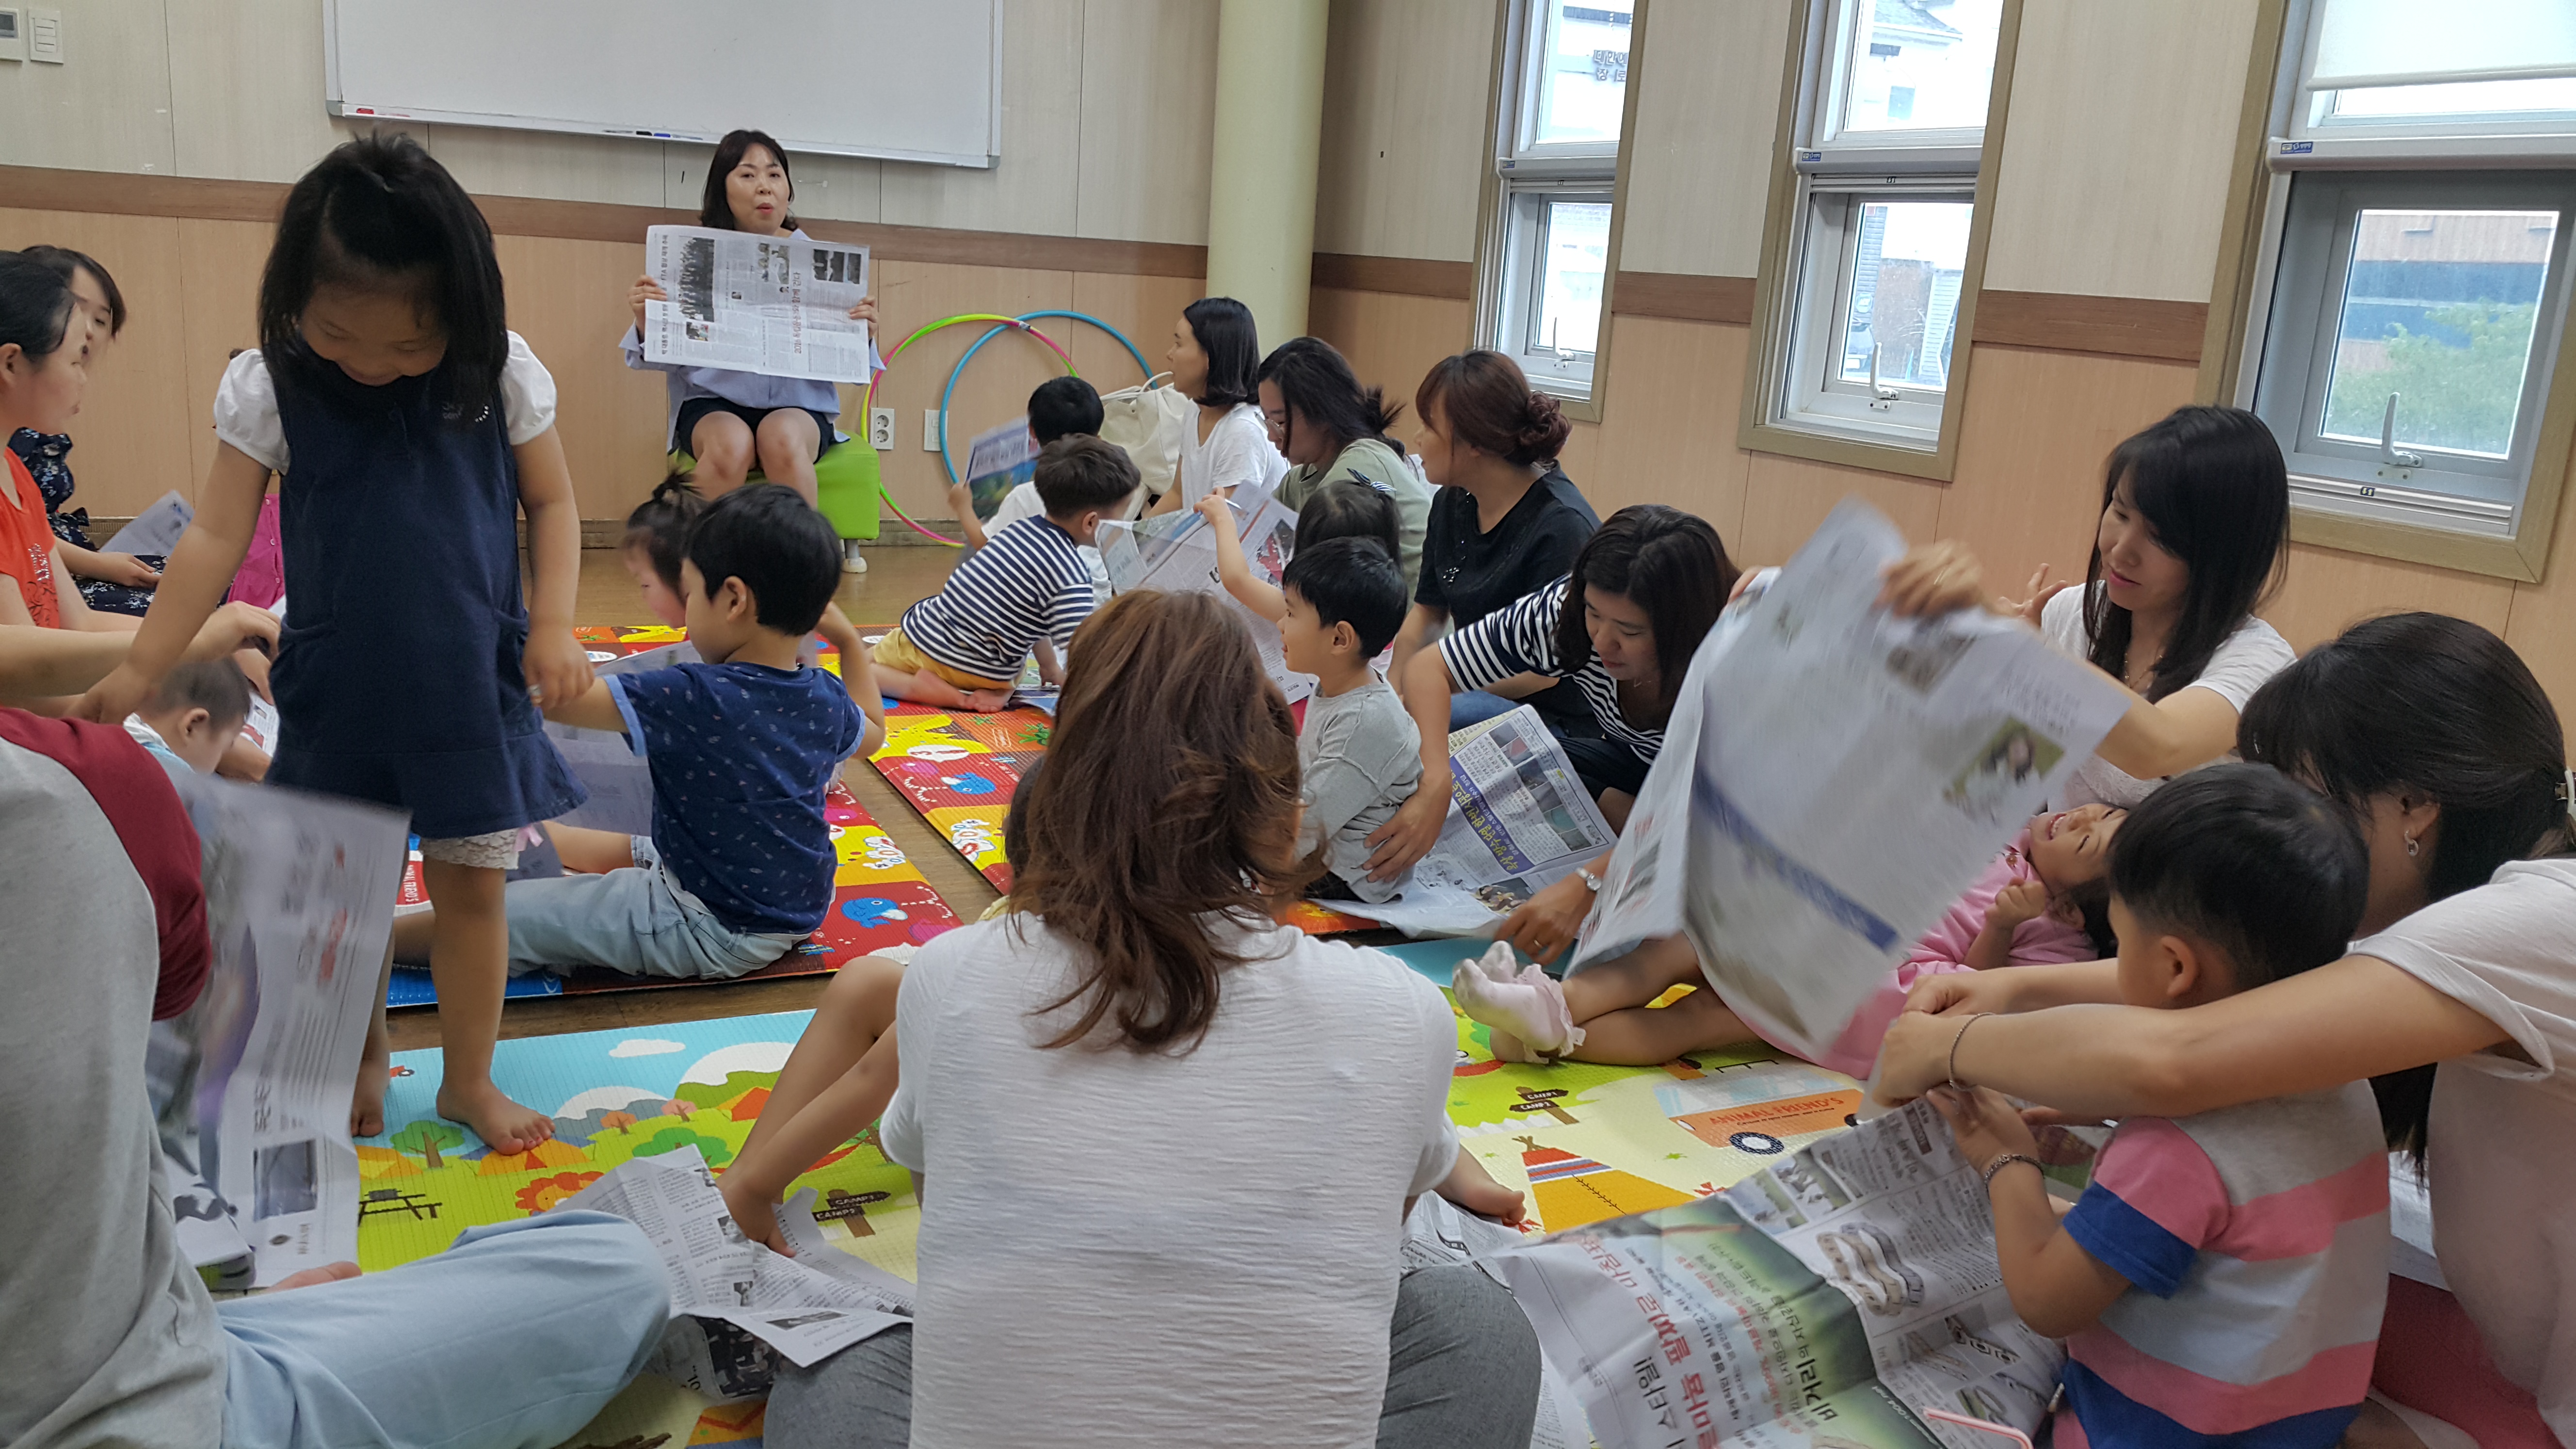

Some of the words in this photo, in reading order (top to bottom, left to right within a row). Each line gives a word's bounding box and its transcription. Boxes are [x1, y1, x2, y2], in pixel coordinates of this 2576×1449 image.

[1478, 823, 1497, 842] 단열
[1489, 838, 1507, 856] 방수
[1501, 855, 1519, 869] 옥상
[1709, 1109, 1774, 1125] ANIMAL
[1635, 1292, 1692, 1366] 팔찌로
[1767, 1327, 1794, 1386] 디자인으로
[1633, 1356, 1677, 1428] 스타일!
[1795, 1344, 1838, 1422] 비거리의
